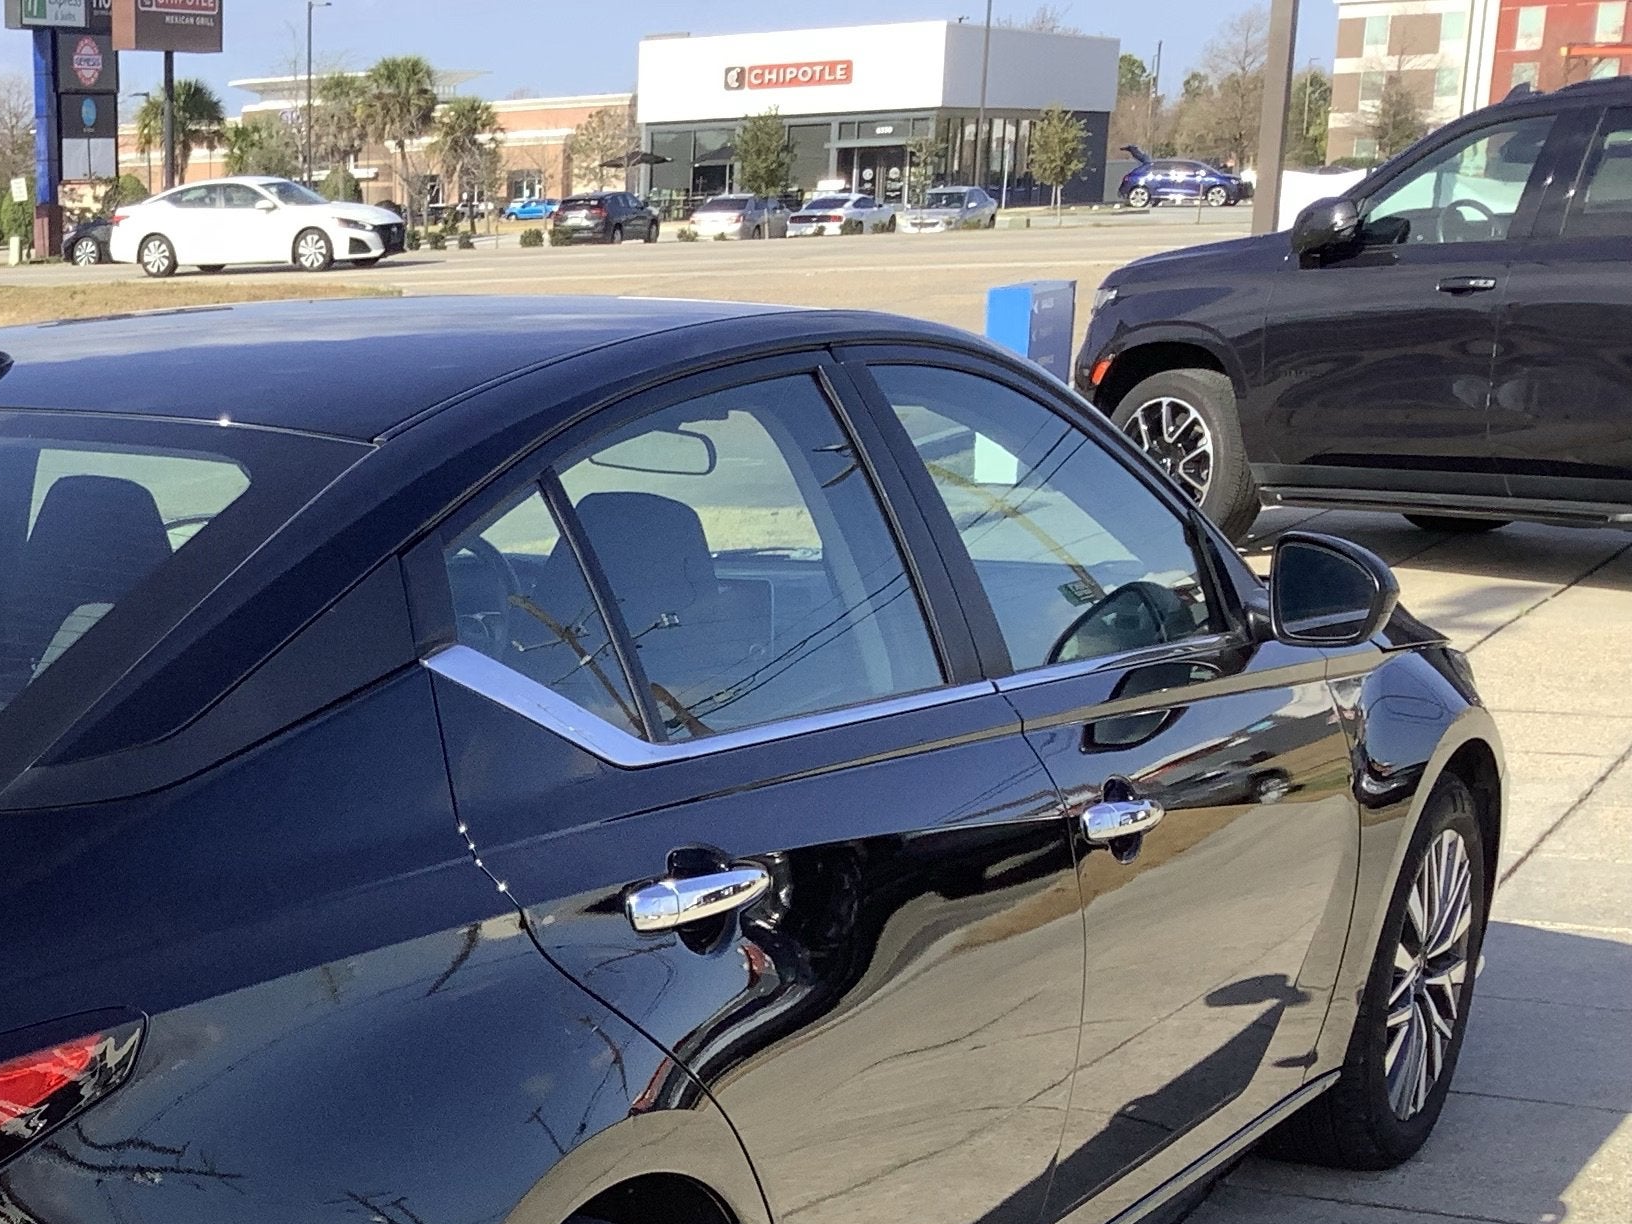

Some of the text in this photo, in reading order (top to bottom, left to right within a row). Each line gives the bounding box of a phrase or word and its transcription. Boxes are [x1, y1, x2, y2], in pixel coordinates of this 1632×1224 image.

[165, 15, 215, 27] MEXICAN GRILL
[750, 63, 848, 85] CHIPOTLE
